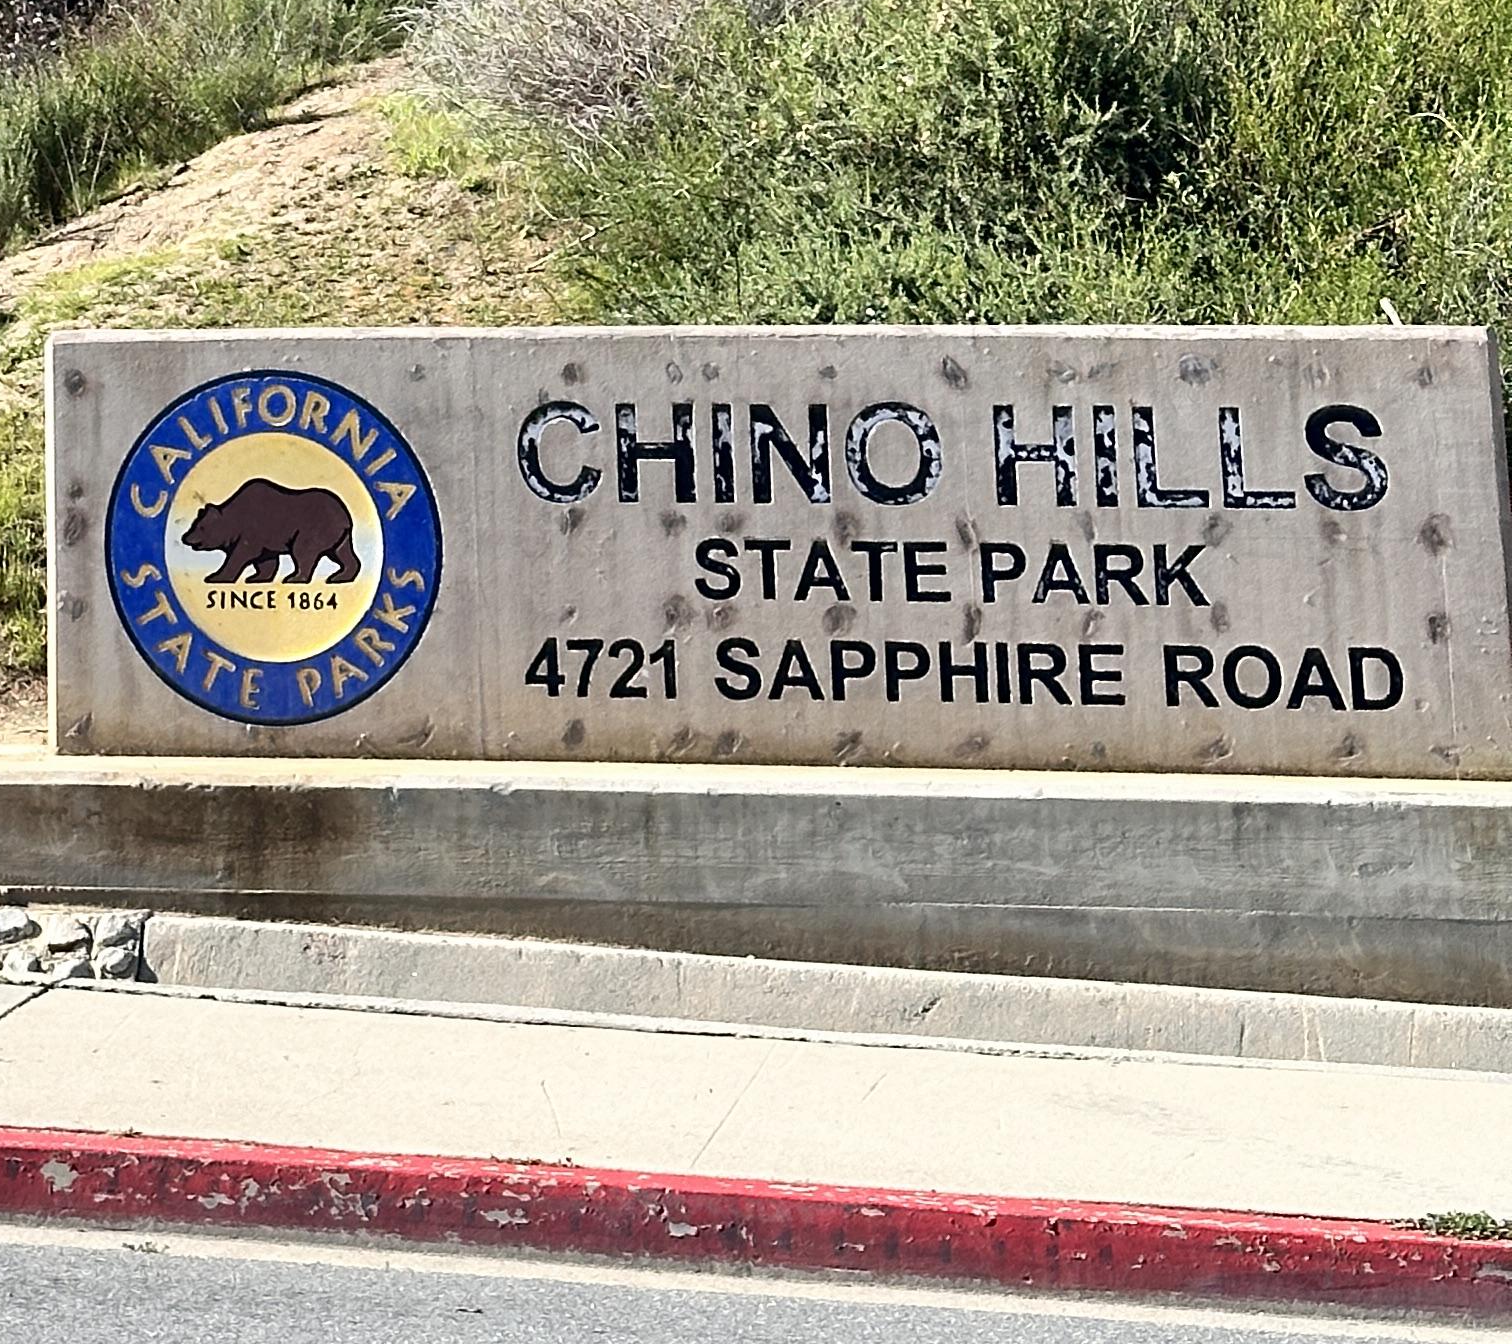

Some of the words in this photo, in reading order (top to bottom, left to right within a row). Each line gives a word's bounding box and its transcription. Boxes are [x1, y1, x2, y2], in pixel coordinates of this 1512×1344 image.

[130, 385, 417, 521] CALIFORNIA
[516, 400, 944, 507] CHINO
[992, 404, 1390, 512] HILLS
[205, 590, 276, 610] SINCE
[287, 592, 339, 611] 1864
[694, 538, 948, 604] STATE
[980, 542, 1211, 608] PARK
[121, 564, 263, 710] STATE
[296, 568, 426, 707] PARKS
[525, 637, 679, 700] 4721
[714, 638, 1127, 708] SAPPHIRE
[1165, 645, 1406, 713] ROAD
